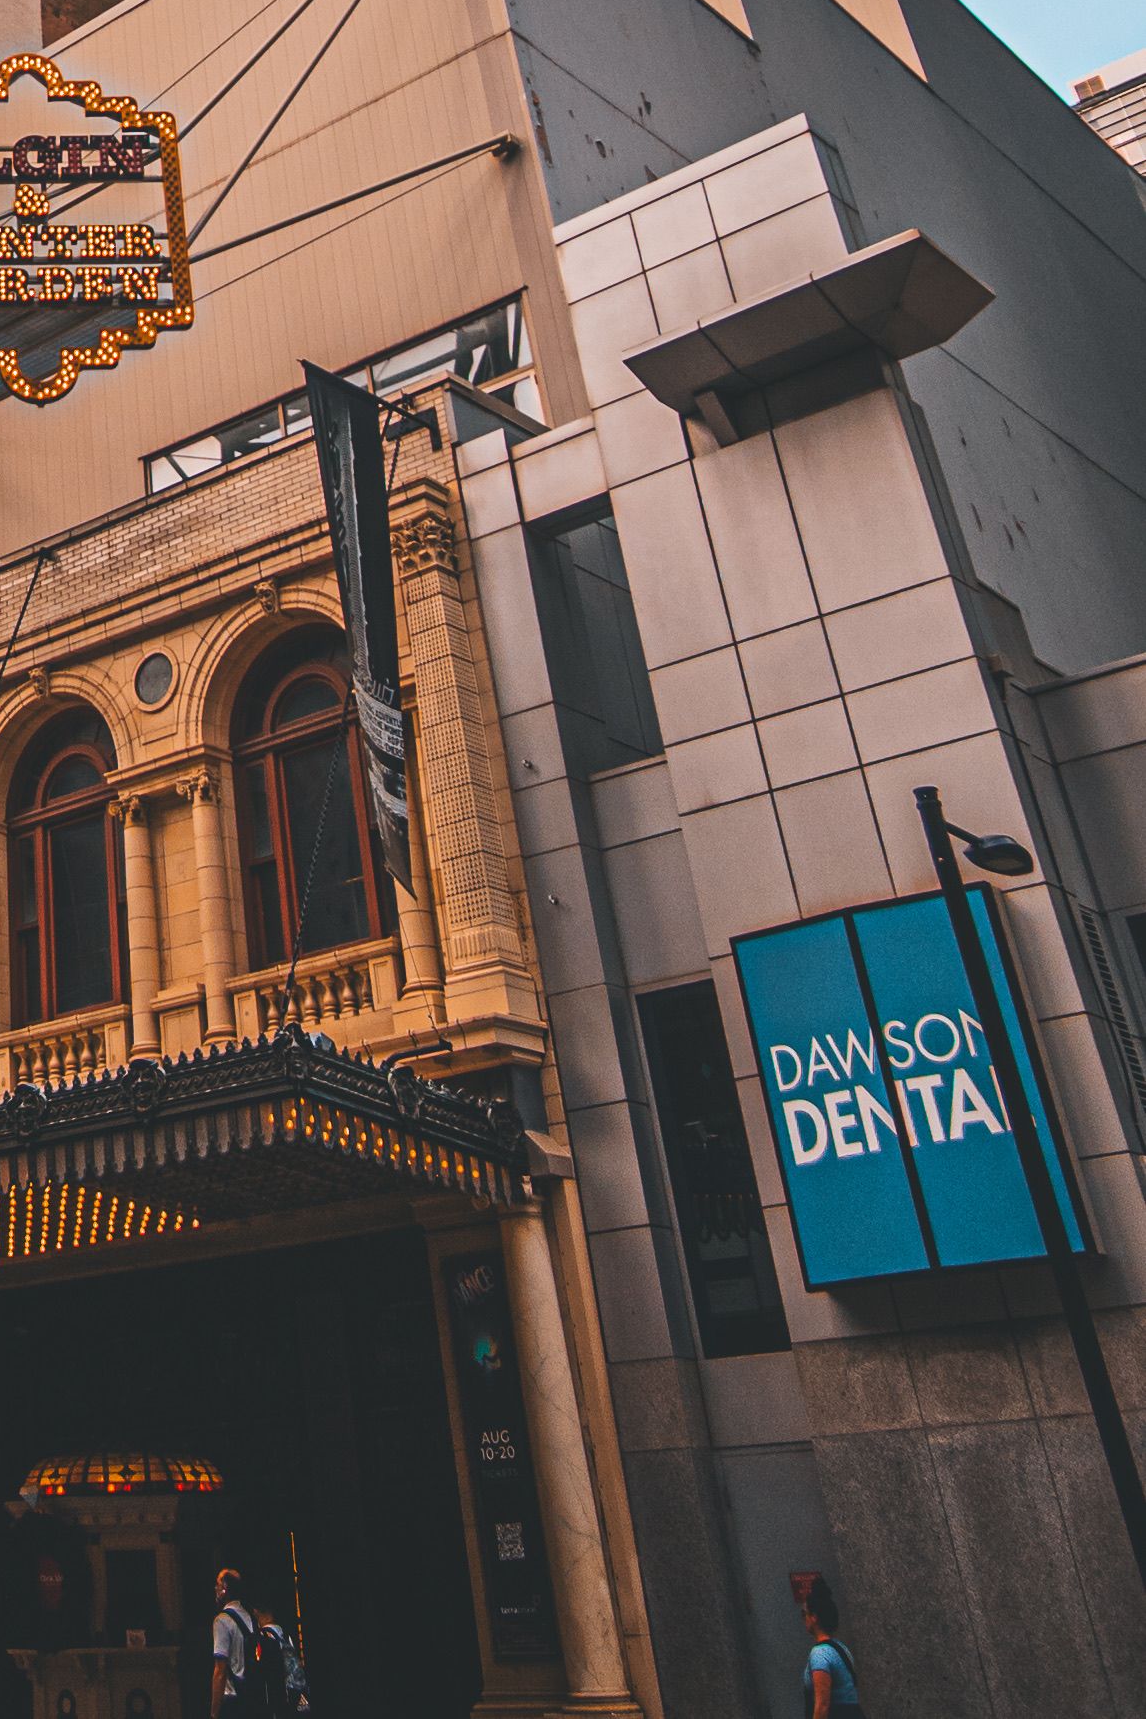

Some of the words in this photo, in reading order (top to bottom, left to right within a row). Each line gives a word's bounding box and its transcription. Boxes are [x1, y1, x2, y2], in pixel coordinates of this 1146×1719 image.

[14, 184, 51, 218] &
[481, 1429, 510, 1444] AUG
[480, 1445, 515, 1461] 10-20
